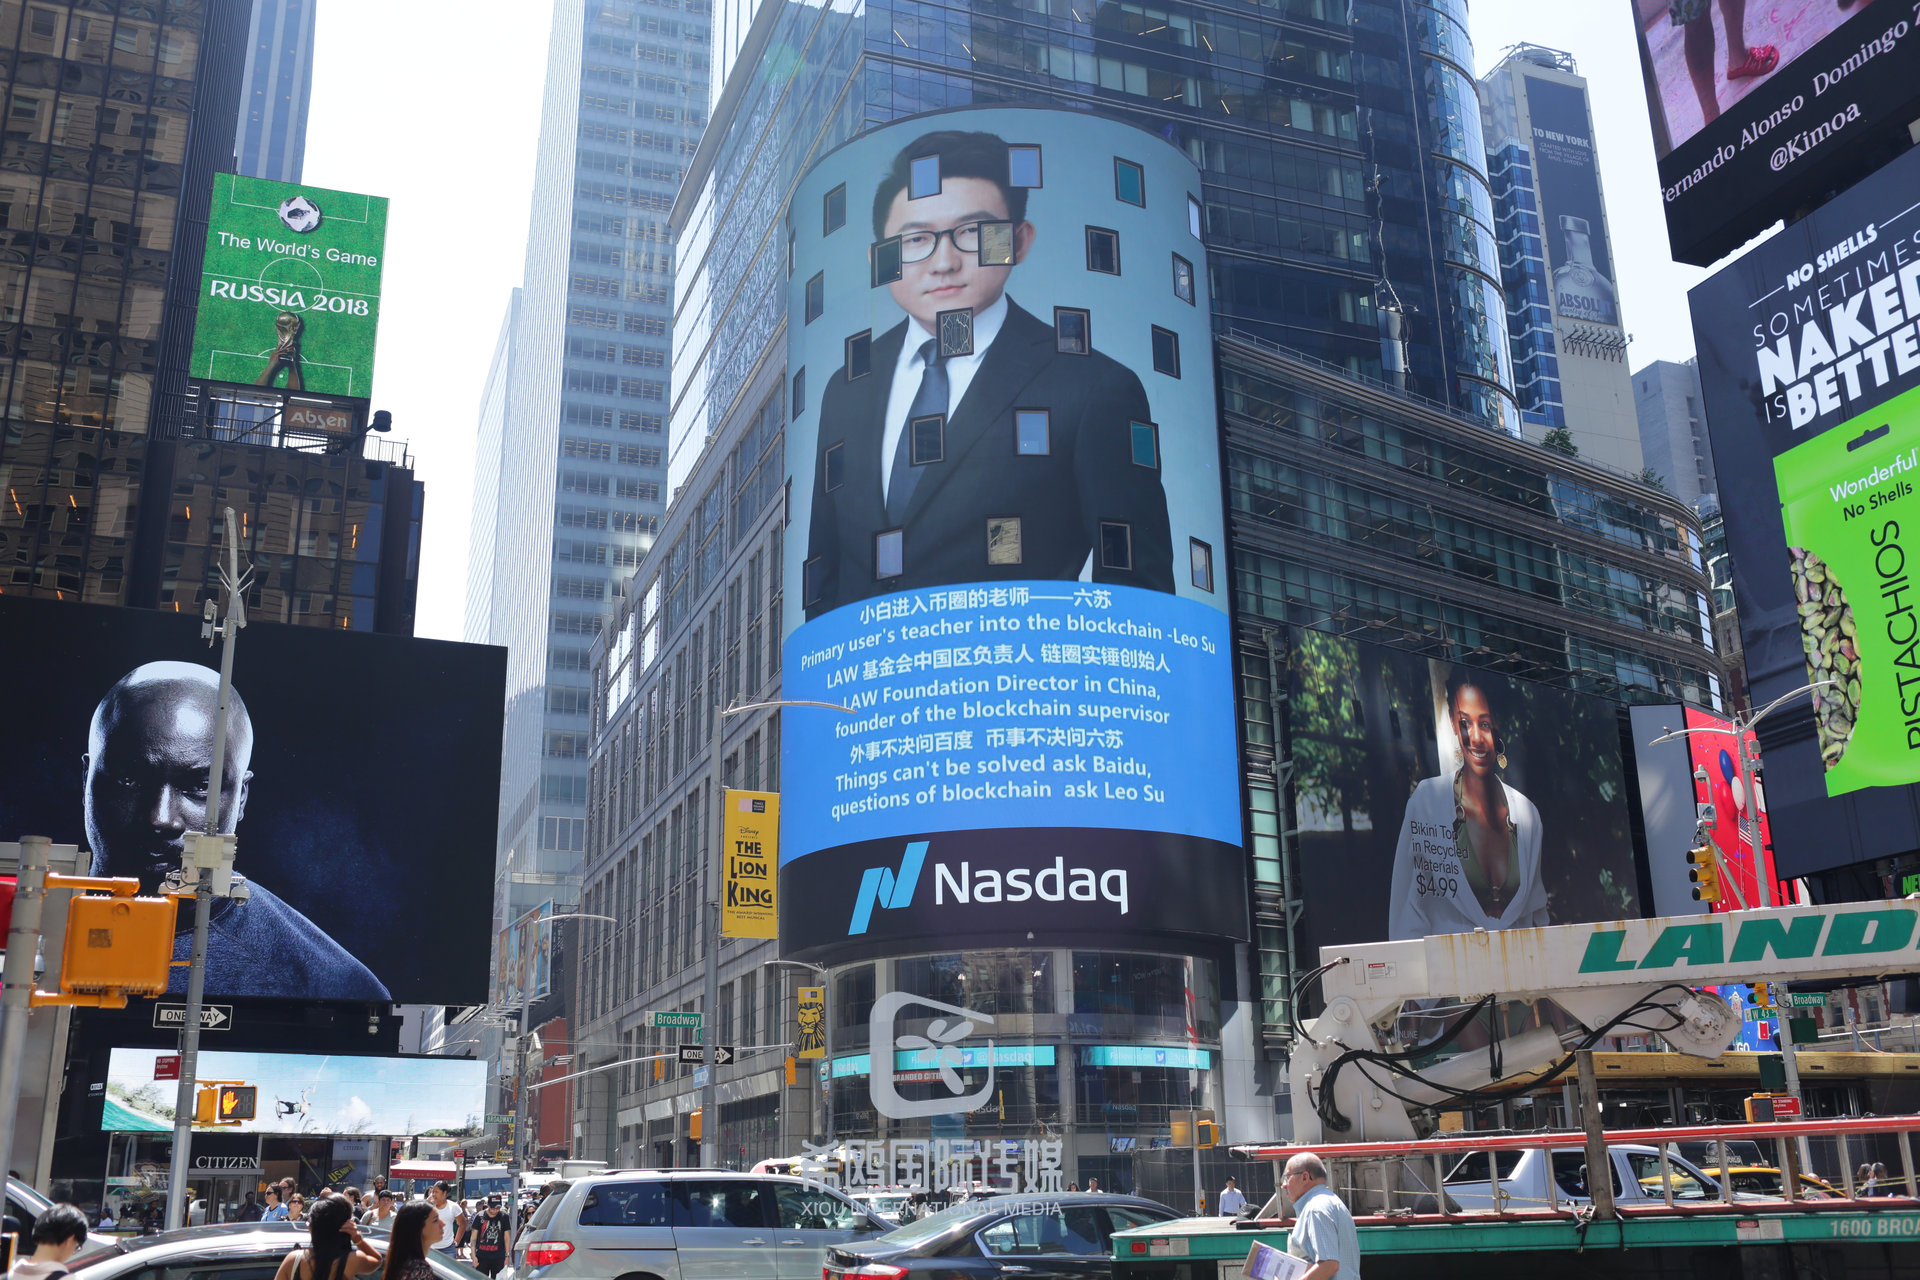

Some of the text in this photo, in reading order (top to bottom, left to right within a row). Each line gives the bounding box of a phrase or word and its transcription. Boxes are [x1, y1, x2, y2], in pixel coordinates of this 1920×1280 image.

[1740, 95, 1804, 150] Alonso
[1812, 20, 1908, 97] Domingo
[1533, 127, 1544, 138] TO
[1545, 130, 1564, 142] NEW
[1769, 103, 1862, 172] @Kimoa
[217, 231, 378, 267] The World's Game
[1786, 223, 1877, 292] NO SHELLS
[210, 279, 369, 316] RUSSIA 2018
[1560, 292, 1606, 312] ABSOL
[1765, 319, 1920, 430] IS BETTE
[290, 410, 347, 429] Absen
[1829, 448, 1918, 502] Wonderful
[1843, 481, 1913, 521] No Shells
[801, 642, 845, 672] Primary
[848, 629, 896, 651] user's
[901, 618, 973, 640] teacher
[979, 615, 1020, 632] into
[1027, 613, 1060, 631] the
[1067, 614, 1162, 640] blockchain
[1201, 635, 1216, 654] Su
[827, 644, 1171, 689] LAW 基金会中国区负责人 链圈实锤创始人
[843, 675, 1160, 711] LAW Foundation Director in China,
[835, 699, 1170, 739] founder of the blockchain supervisor
[850, 730, 973, 765] 外事不决问百度
[835, 754, 1151, 792] Things can't be solved ask Baidu,
[831, 780, 1165, 822] questions of blockchain ask Leo Su
[1410, 820, 1458, 842] Bikini Top
[735, 841, 762, 854] THE
[1412, 838, 1469, 859] in Recycled
[730, 856, 767, 879] LION
[1413, 856, 1459, 875] Materials
[727, 880, 772, 907] KING
[935, 856, 1129, 915] Nasdaq
[1416, 872, 1458, 898] $4.99
[1577, 908, 1920, 974] LAND
[1794, 995, 1824, 1006] Broadway
[166, 1011, 220, 1022] ONE WAY
[657, 1014, 700, 1027] Broadway
[1752, 1010, 1759, 1020] W
[1761, 1009, 1770, 1018] 43
[1397, 1030, 1419, 1039] NLINE
[1736, 1042, 1750, 1051] GO
[687, 1051, 726, 1060] ONE AY
[892, 1072, 947, 1082] BRANDED CITI
[195, 1156, 259, 1169] CITIZEN
[1831, 1219, 1871, 1236] 1600
